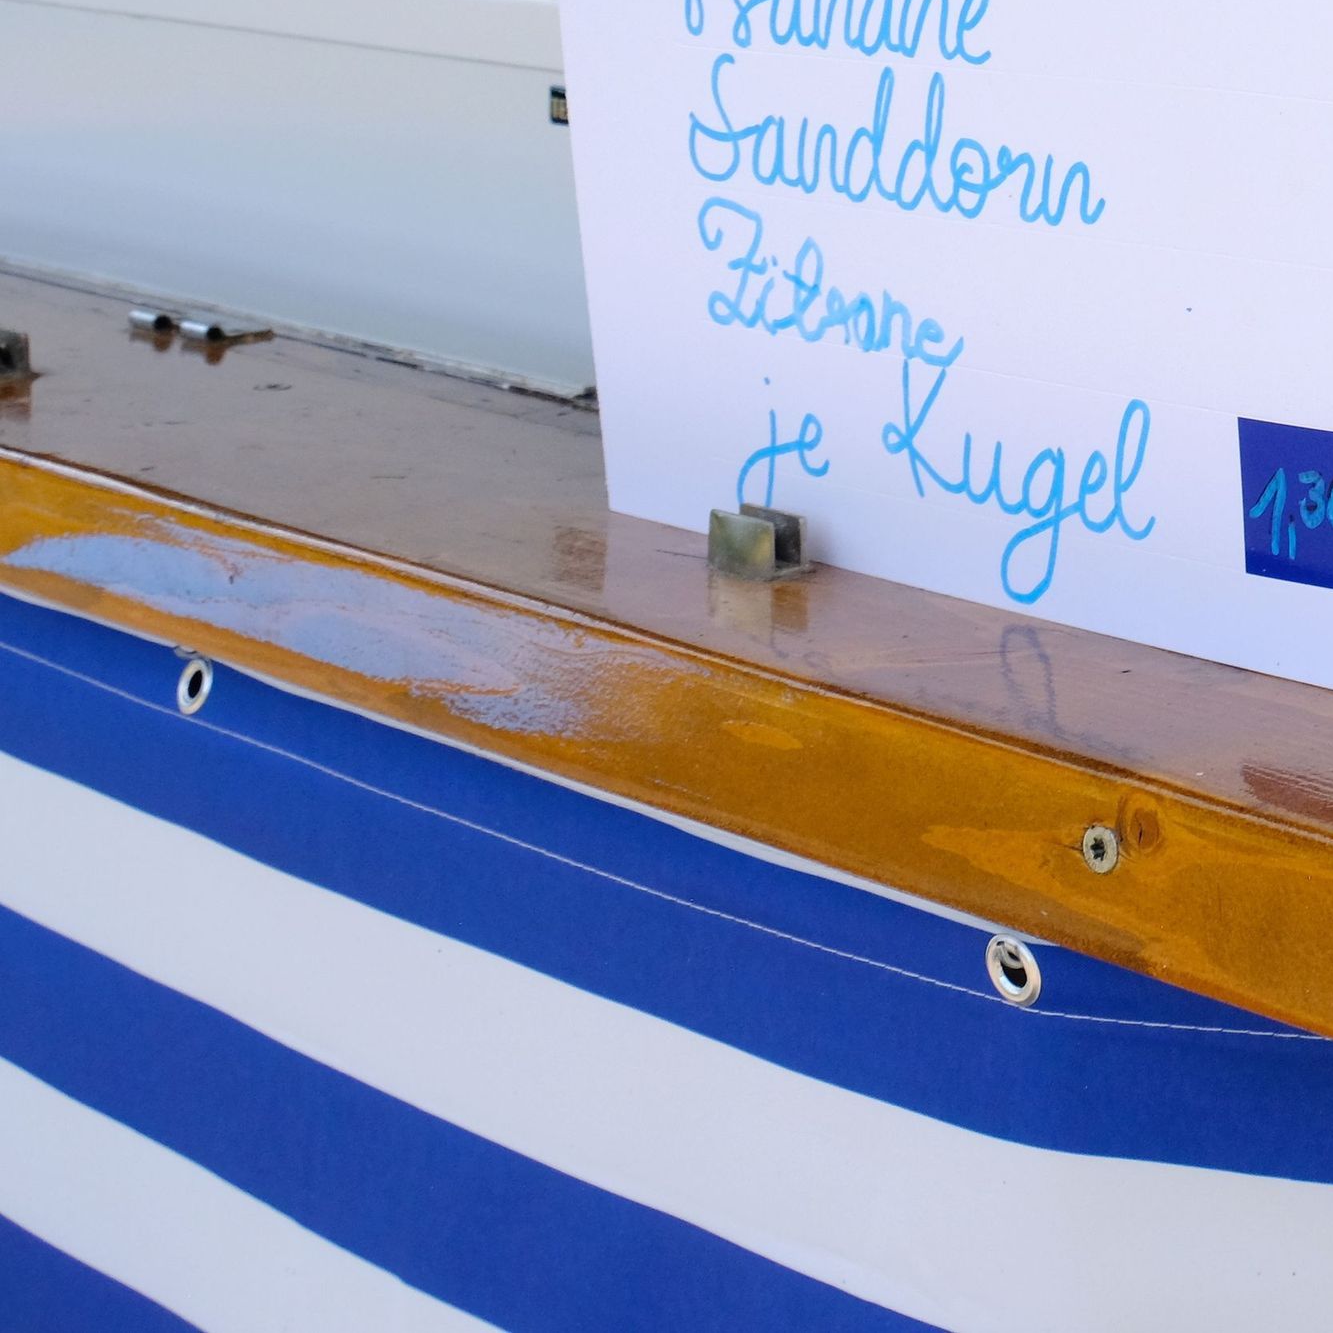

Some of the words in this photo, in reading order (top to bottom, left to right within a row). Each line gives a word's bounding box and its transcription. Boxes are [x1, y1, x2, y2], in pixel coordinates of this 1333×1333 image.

[688, 53, 1106, 227] Sanddorn
[697, 196, 965, 368] Zitrone
[735, 377, 832, 509] je
[881, 358, 1157, 608] Kugel
